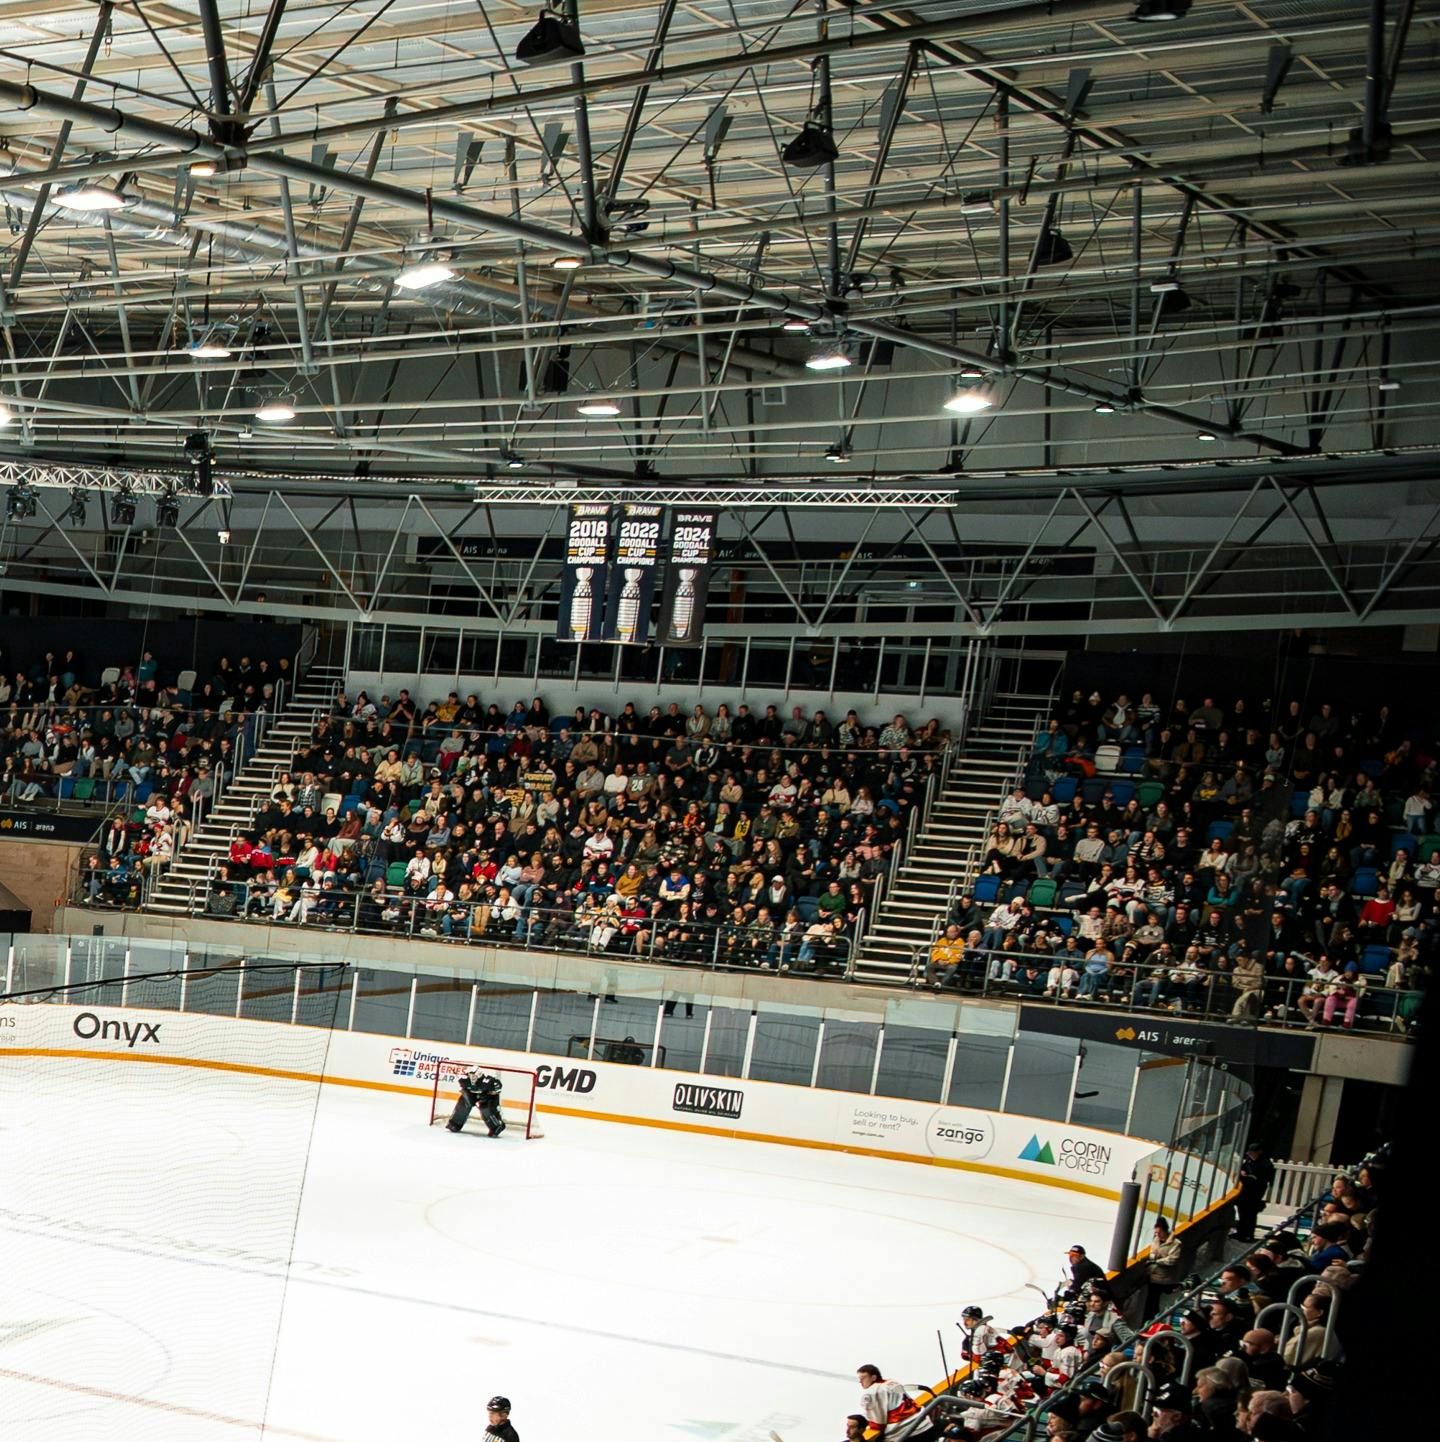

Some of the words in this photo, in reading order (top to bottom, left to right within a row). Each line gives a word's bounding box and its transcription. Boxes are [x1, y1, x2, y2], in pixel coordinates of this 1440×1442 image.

[570, 520, 608, 537] 2018
[620, 521, 659, 538] 2022
[674, 527, 711, 541] 2024
[568, 538, 607, 547] GOODALL
[619, 538, 657, 548] GOODALL
[673, 541, 709, 550] GOODALL
[578, 547, 596, 556] CUP
[627, 548, 646, 557] CUP
[681, 549, 699, 557] CUP
[13, 821, 27, 830] AIS
[35, 824, 55, 832] arena
[73, 1011, 161, 1048] Onyx
[1137, 1030, 1159, 1042] AIS
[536, 1064, 597, 1094] GMD
[675, 1085, 743, 1113] OLIVSKIN
[854, 1108, 887, 1121] Looking
[889, 1113, 898, 1121] to
[853, 1118, 867, 1126] sell
[879, 1122, 901, 1131] rent?
[936, 1127, 984, 1144] zango
[1060, 1138, 1111, 1161] CORIN
[1058, 1152, 1109, 1175] FOREST
